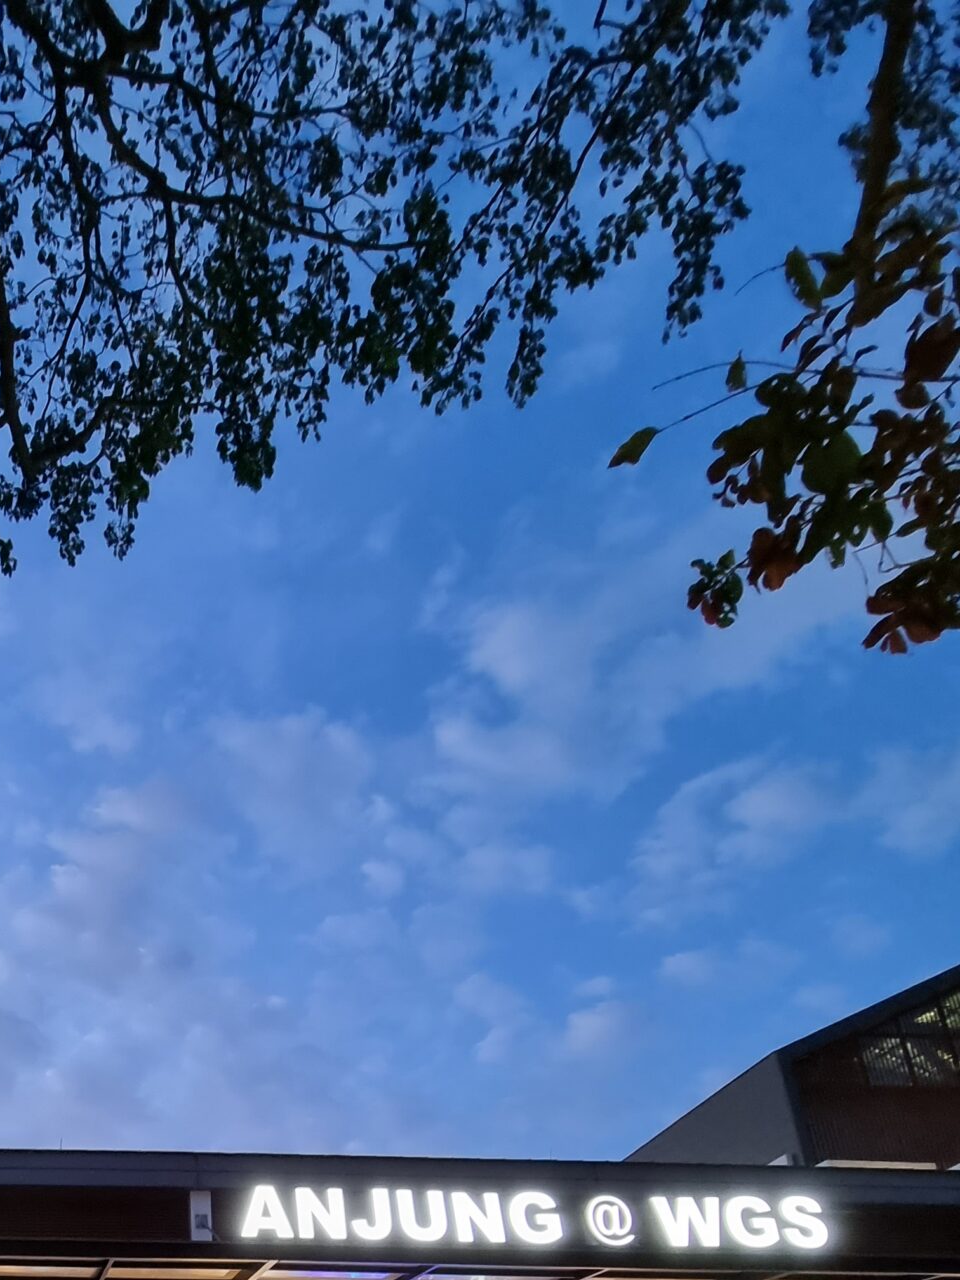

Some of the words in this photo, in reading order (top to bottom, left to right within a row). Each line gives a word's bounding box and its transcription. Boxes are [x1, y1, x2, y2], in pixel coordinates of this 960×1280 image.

[240, 1184, 565, 1245] ANJUNG
[584, 1195, 636, 1246] @
[648, 1195, 830, 1250] WGS
